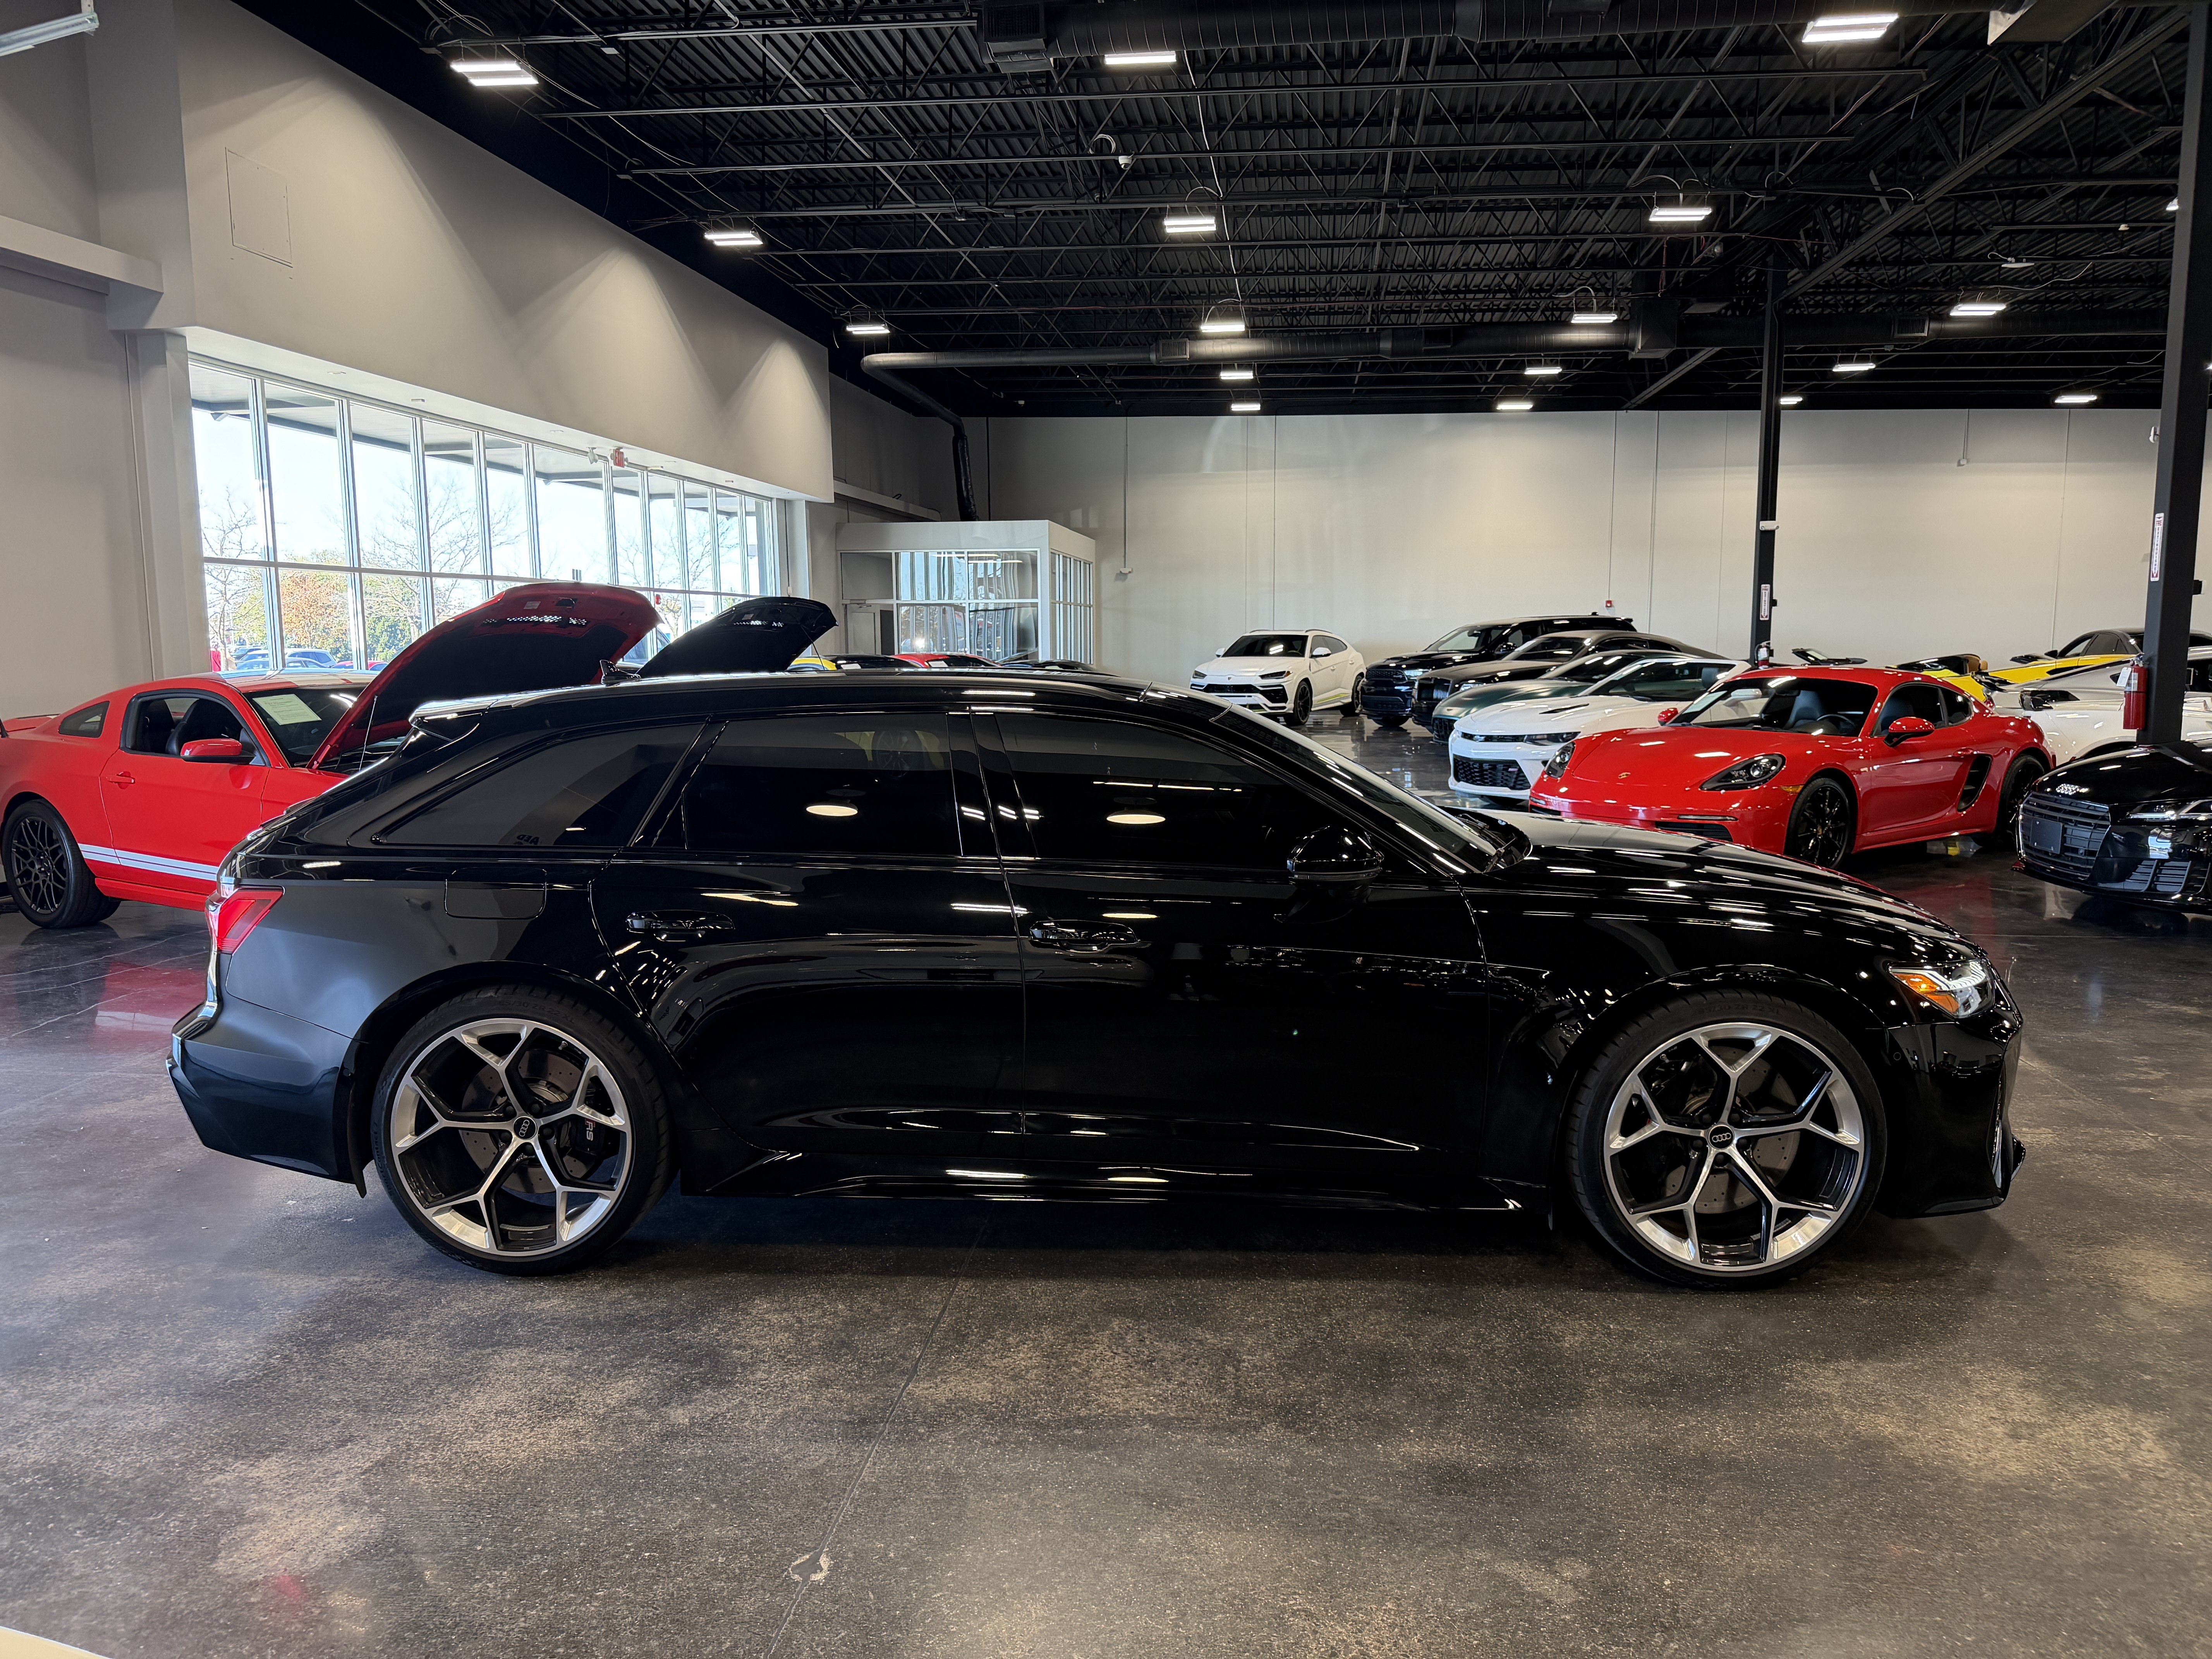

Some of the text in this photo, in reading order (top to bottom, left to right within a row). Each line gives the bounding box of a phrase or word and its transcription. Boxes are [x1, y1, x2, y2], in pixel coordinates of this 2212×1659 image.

[615, 450, 624, 466] EXIT
[547, 1008, 561, 1017] 22
[586, 1120, 593, 1141] RS
